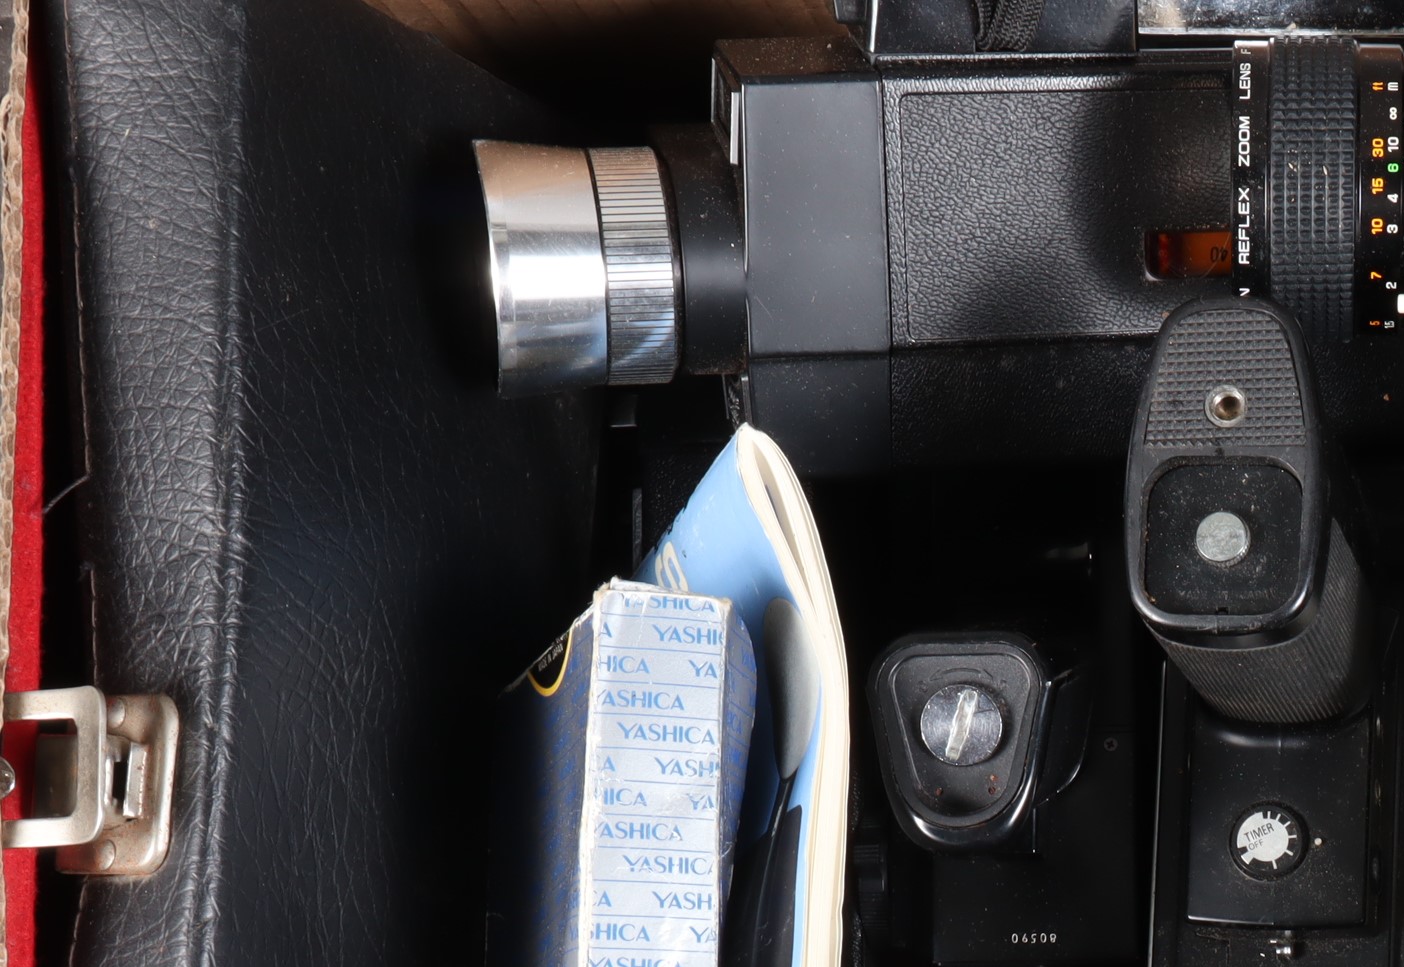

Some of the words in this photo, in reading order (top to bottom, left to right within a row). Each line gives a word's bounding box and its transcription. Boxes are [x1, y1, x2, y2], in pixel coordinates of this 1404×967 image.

[1238, 62, 1252, 100] LENS
[1237, 115, 1251, 167] ZOOM
[1371, 137, 1384, 158] 30
[1387, 136, 1400, 153] 10
[1387, 162, 1399, 173] 6
[1371, 177, 1384, 195] 15
[1386, 193, 1399, 204] 4
[1237, 186, 1251, 265] REFLEX
[1371, 217, 1384, 235] 10
[1386, 223, 1399, 234] 3
[1370, 271, 1383, 280] 7
[1385, 281, 1397, 290] 2
[616, 721, 716, 746] YASHICA
[1243, 822, 1275, 843] TIMER
